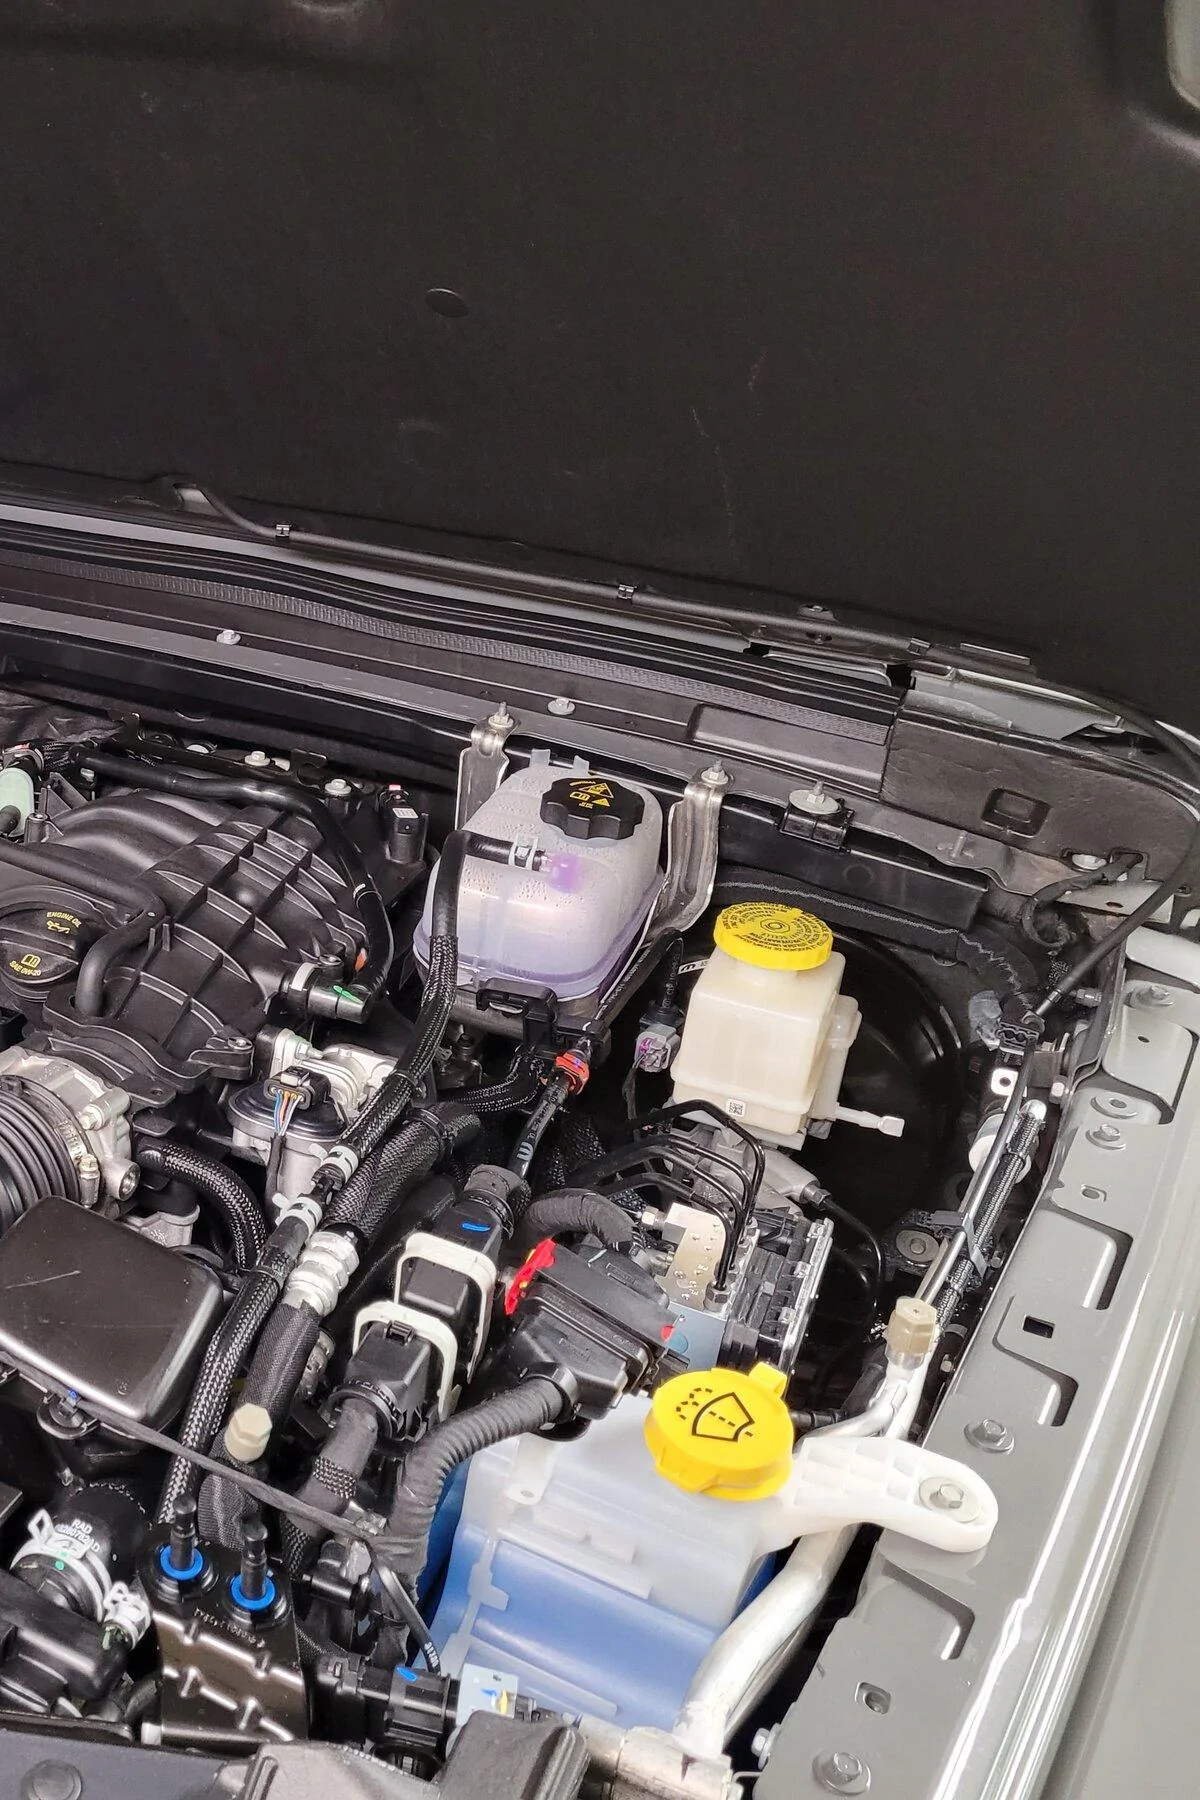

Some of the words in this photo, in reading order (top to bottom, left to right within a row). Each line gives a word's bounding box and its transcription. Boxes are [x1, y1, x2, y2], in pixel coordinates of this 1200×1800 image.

[47, 911, 74, 922] ENGINE
[71, 917, 82, 928] OIL
[9, 960, 23, 972] SAE
[71, 1518, 93, 1535] RAD
